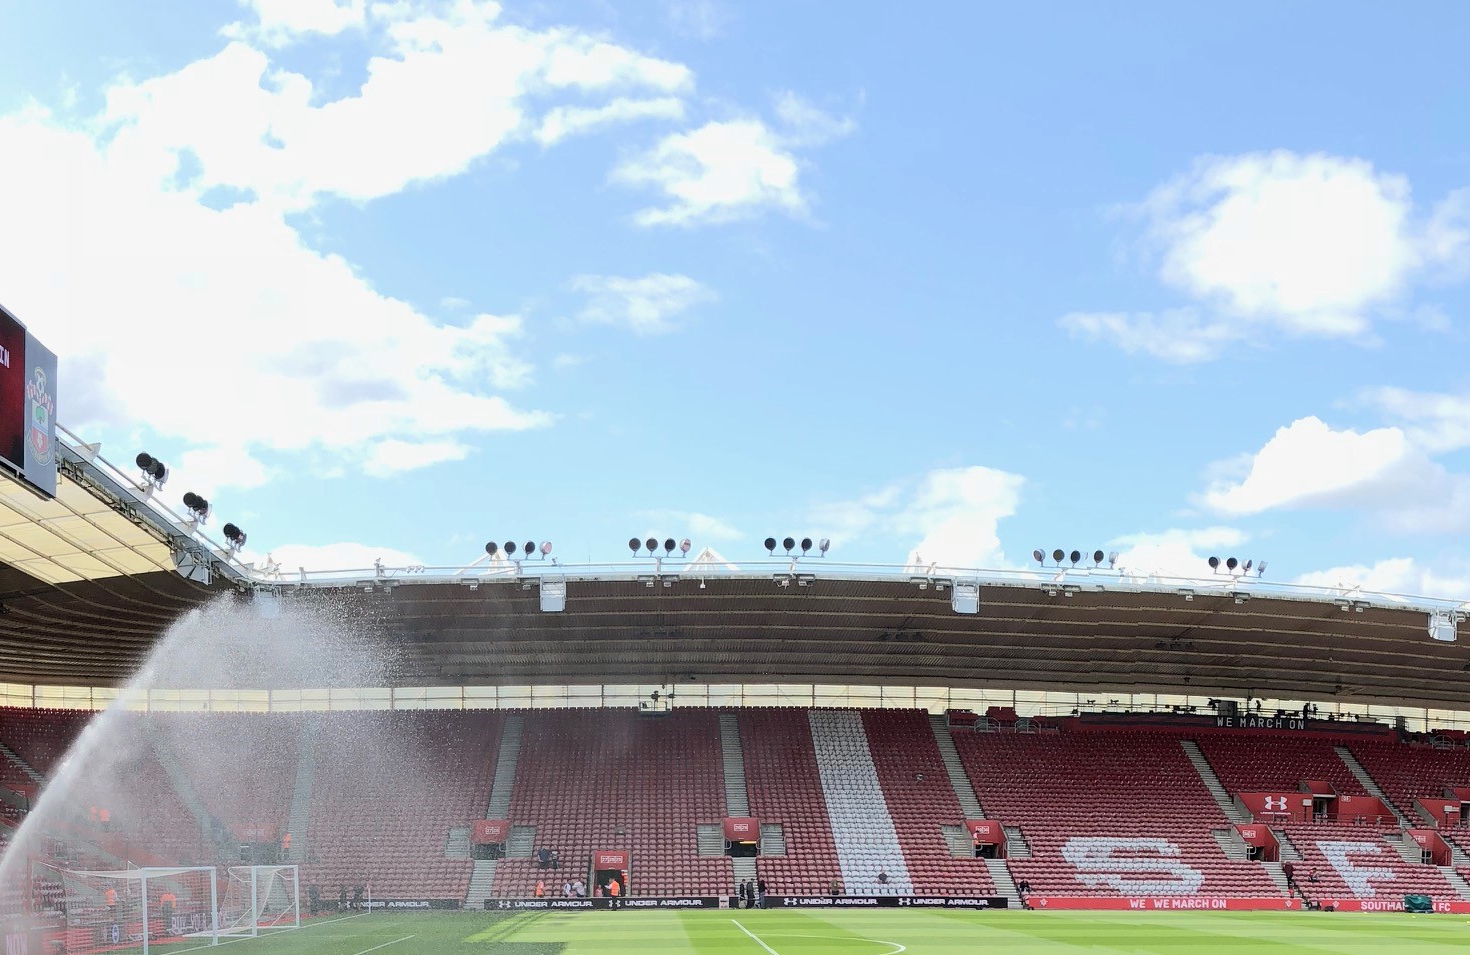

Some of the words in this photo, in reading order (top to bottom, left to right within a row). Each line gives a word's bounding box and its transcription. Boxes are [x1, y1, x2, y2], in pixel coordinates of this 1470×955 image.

[1216, 717, 1232, 727] WE
[1239, 718, 1282, 729] MARCH
[1289, 720, 1305, 730] ON
[515, 900, 544, 908] UNDER
[547, 900, 590, 908] ARMOUR
[833, 898, 878, 906] ARMOUR
[913, 898, 944, 906] UNDER
[1129, 899, 1146, 909] WE
[1154, 899, 1170, 909] WE
[1172, 899, 1210, 909] MARCH
[1212, 899, 1227, 909] ON
[1439, 902, 1451, 912] FC
